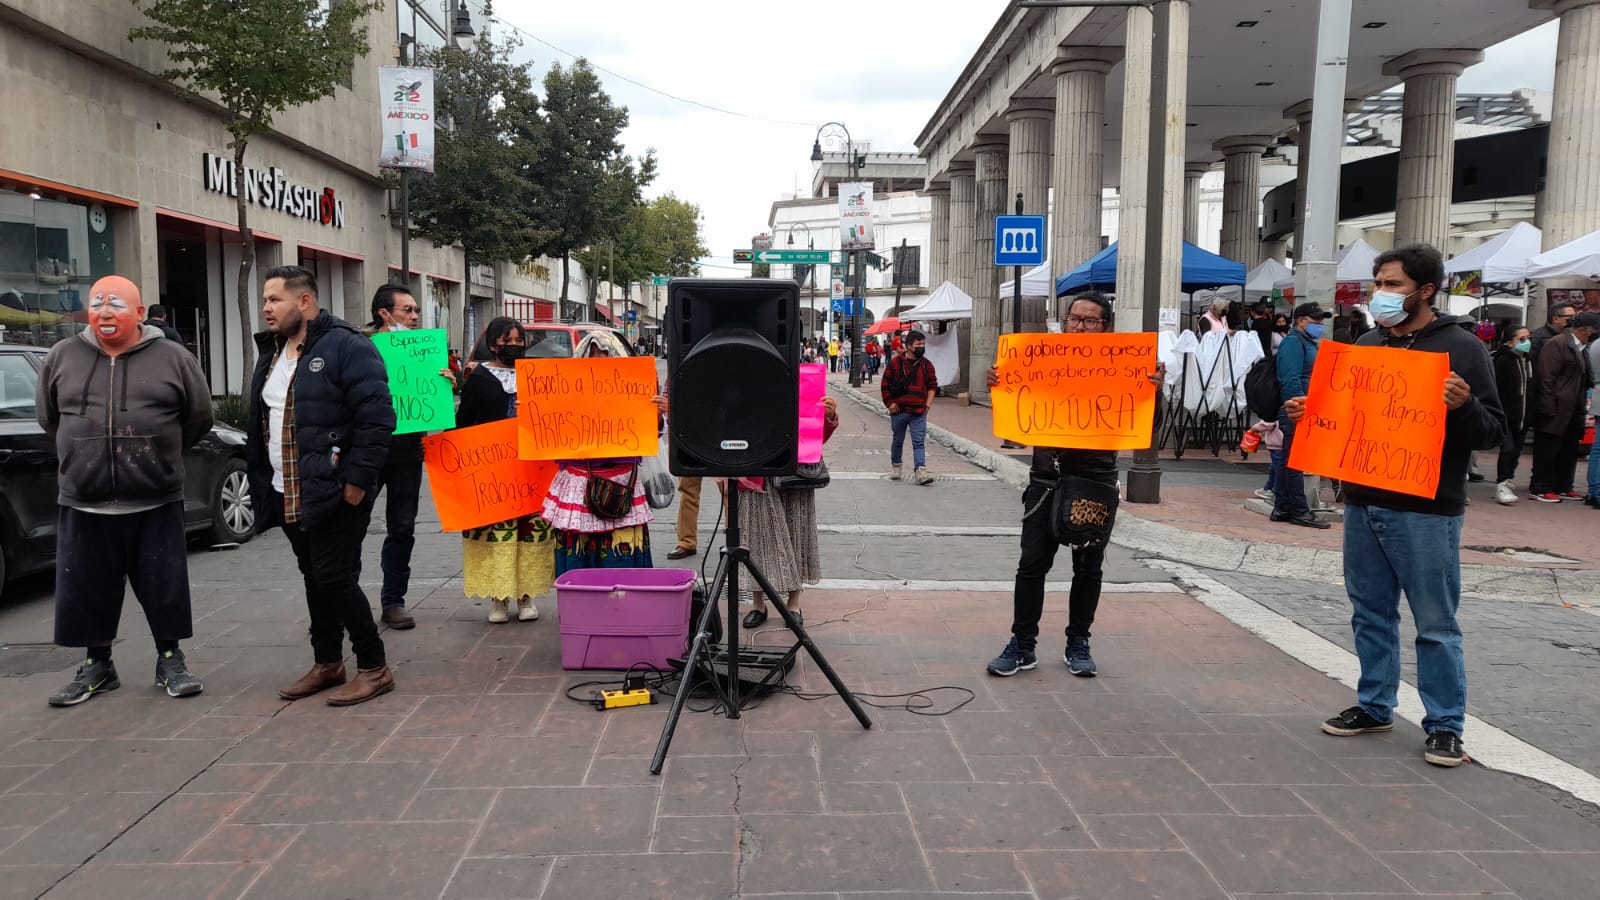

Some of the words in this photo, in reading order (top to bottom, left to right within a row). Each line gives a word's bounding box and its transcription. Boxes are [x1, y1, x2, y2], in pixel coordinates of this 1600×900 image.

[1022, 339, 1092, 367] gobierno
[1100, 344, 1154, 363] opresor
[520, 362, 569, 400] Respeto
[575, 378, 583, 396] a
[590, 366, 614, 395] los
[1005, 370, 1022, 385] es
[1028, 371, 1043, 382] un
[1048, 363, 1117, 387] gobierno
[1124, 365, 1148, 379] sin
[1329, 351, 1408, 399] Espacios
[1381, 394, 1437, 432] dignos
